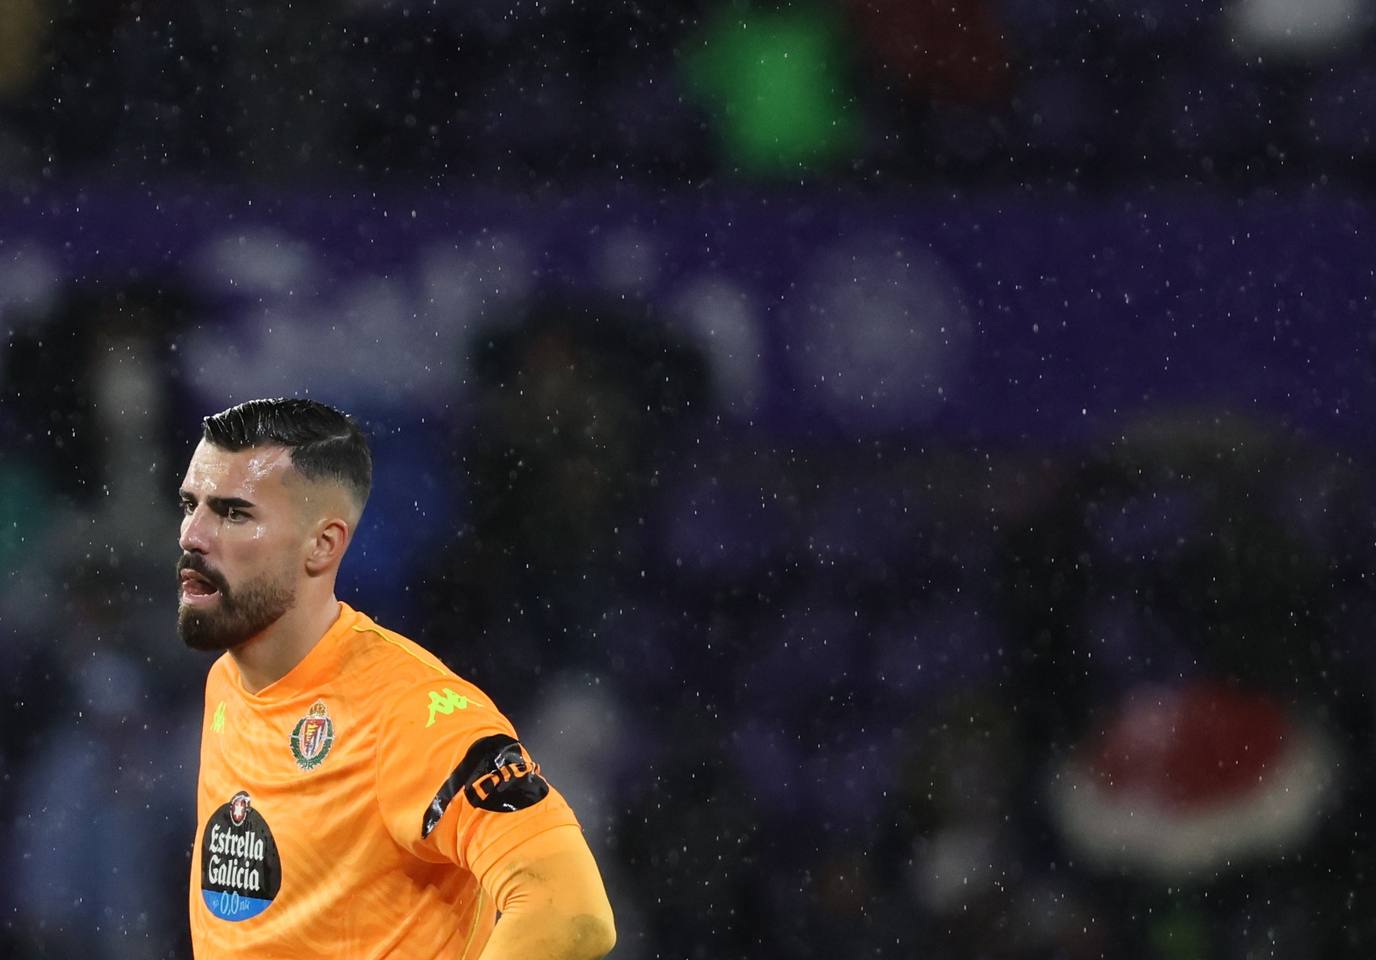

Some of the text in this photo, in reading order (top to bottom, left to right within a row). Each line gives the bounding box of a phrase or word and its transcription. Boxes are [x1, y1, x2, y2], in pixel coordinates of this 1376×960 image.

[209, 823, 264, 861] Estrella
[208, 854, 261, 892] Galicia
[220, 890, 240, 916] 0,0
